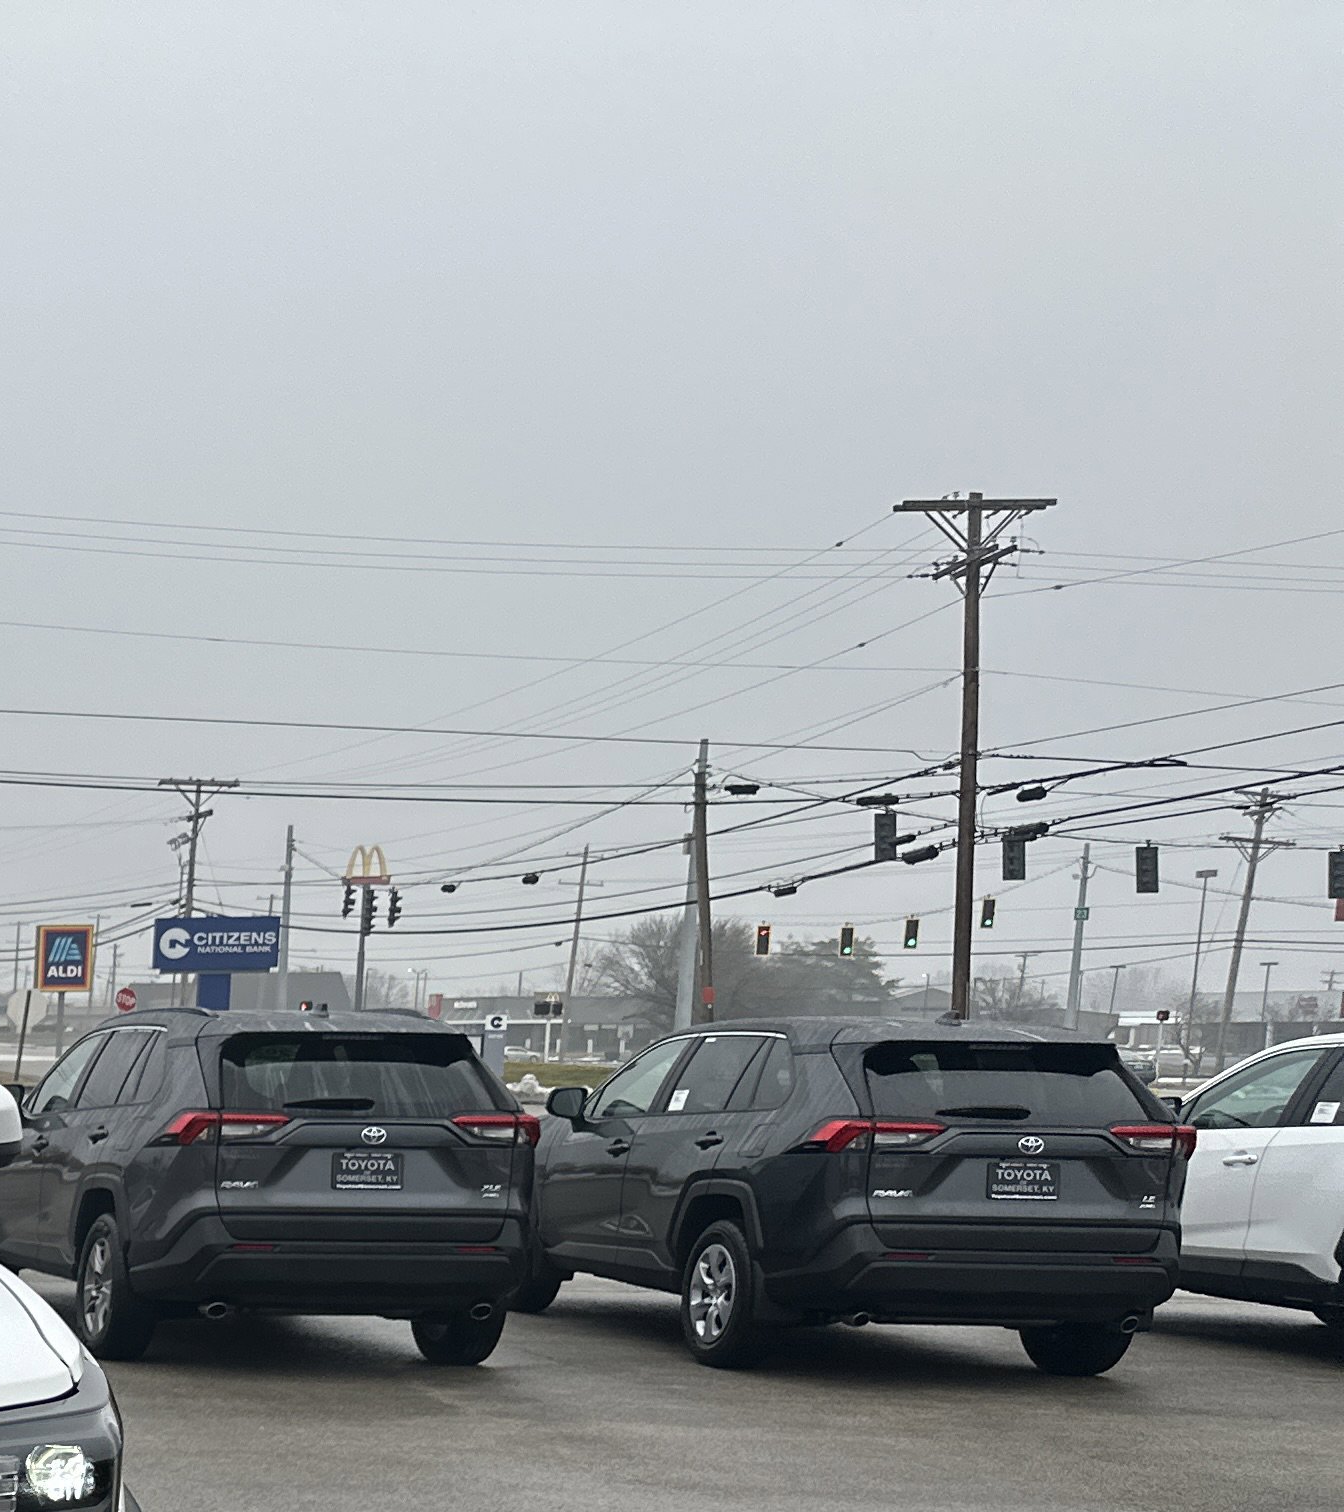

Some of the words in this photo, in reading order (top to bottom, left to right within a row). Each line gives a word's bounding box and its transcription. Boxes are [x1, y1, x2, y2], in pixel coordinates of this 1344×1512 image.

[193, 932, 277, 945] CITIZENS
[197, 945, 243, 953] NATIONAL
[246, 945, 272, 953] BANK
[47, 965, 82, 978] ALDI
[118, 992, 136, 1006] STOP
[340, 1160, 395, 1171] TOYOTA
[996, 1169, 1051, 1180] TOYOTA
